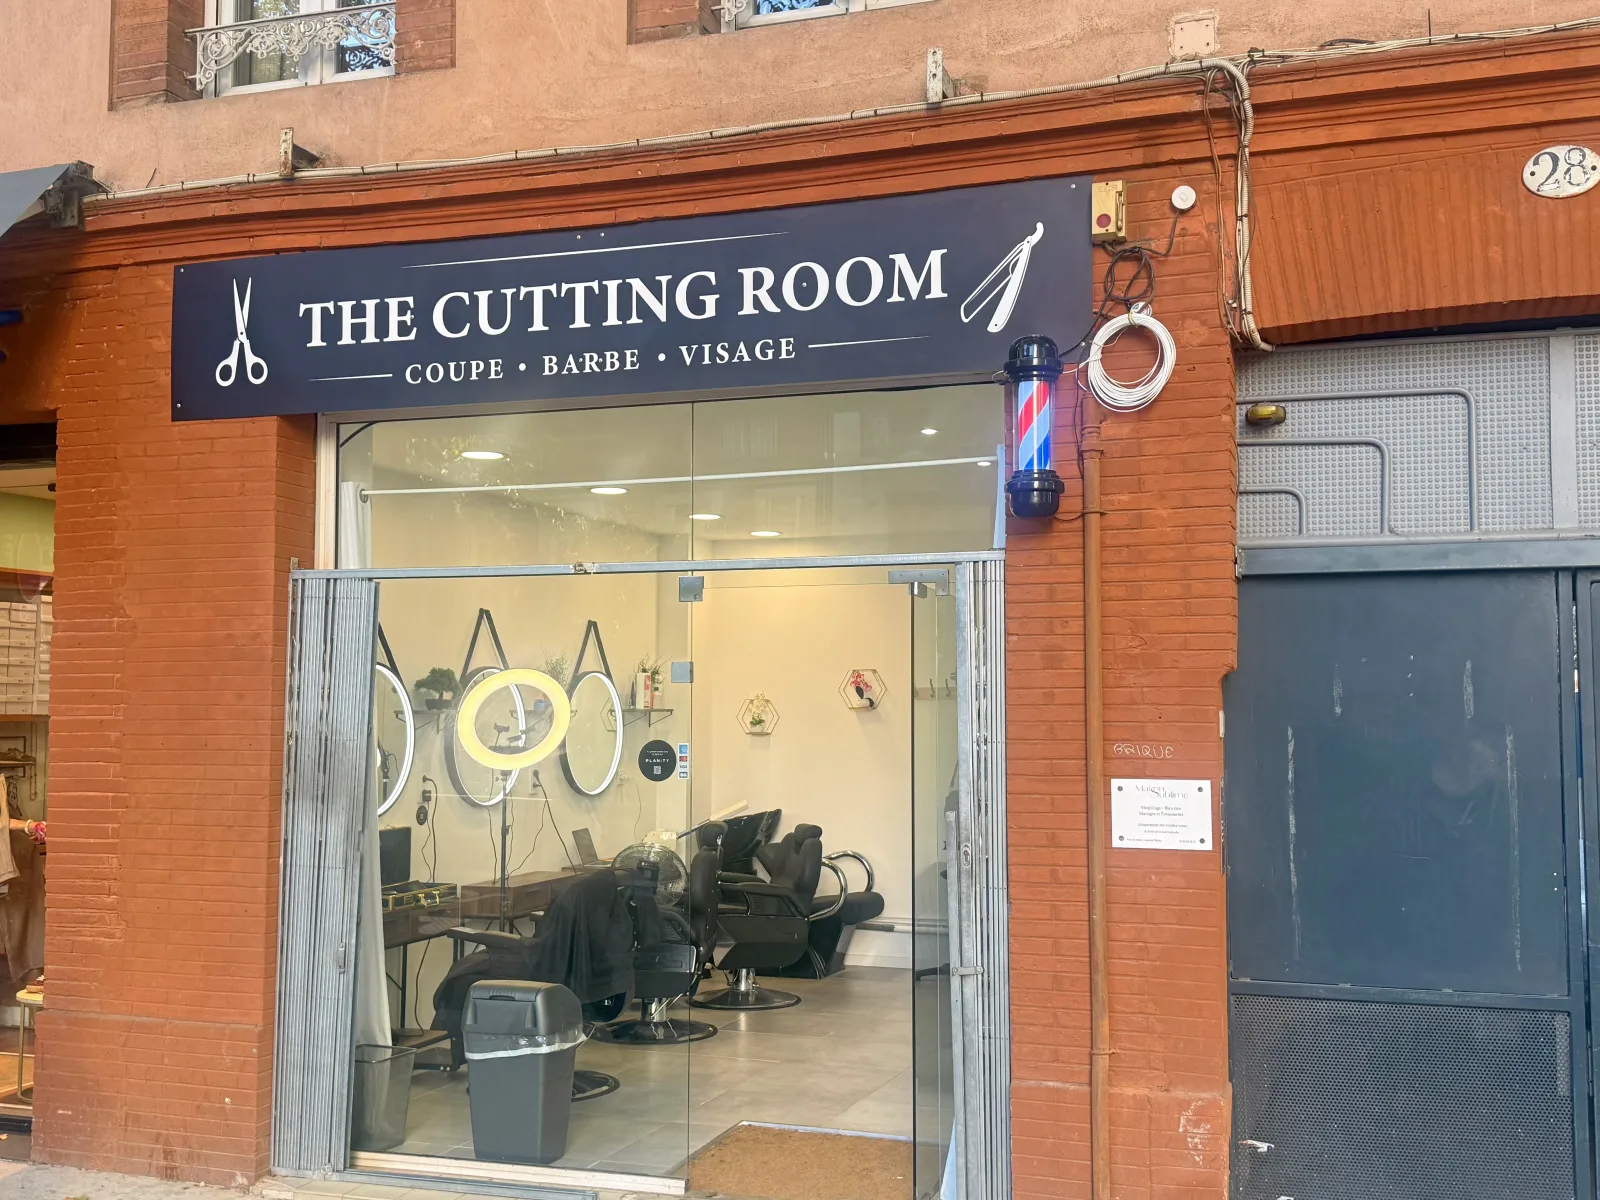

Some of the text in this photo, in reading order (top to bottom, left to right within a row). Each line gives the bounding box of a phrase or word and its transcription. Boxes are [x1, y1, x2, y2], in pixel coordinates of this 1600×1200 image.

[1533, 148, 1591, 192] 28
[299, 249, 948, 347] THE CUTTING ROOM
[405, 337, 796, 384] COUPE BARBE VISAGE
[1114, 743, 1174, 758] BRIQUE
